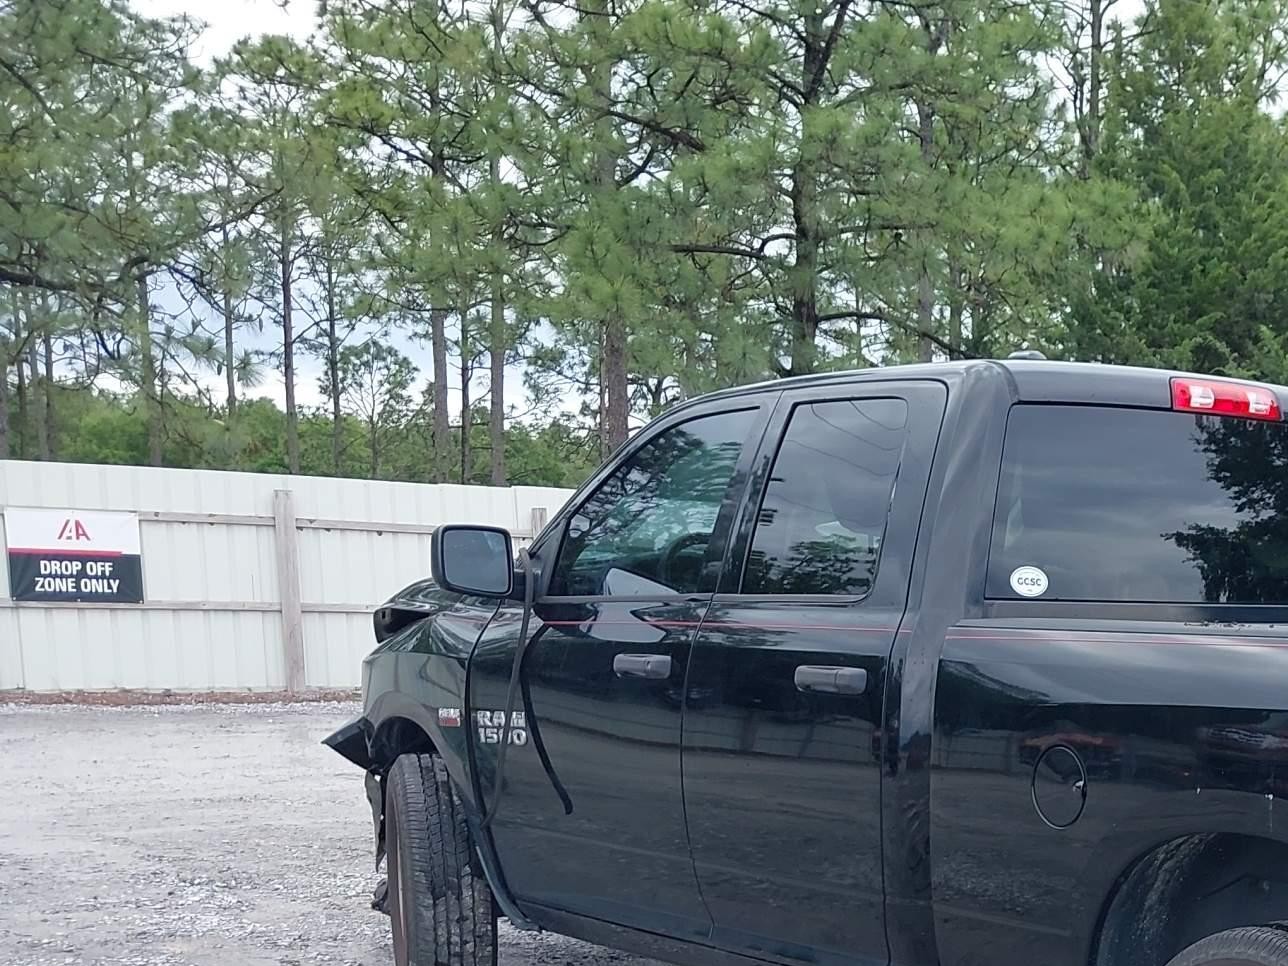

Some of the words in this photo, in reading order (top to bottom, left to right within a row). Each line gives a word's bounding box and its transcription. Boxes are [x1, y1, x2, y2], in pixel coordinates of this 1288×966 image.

[40, 560, 82, 575] DROP
[86, 561, 113, 576] OFF
[35, 577, 77, 592] ZONE
[80, 578, 120, 593] ONLY
